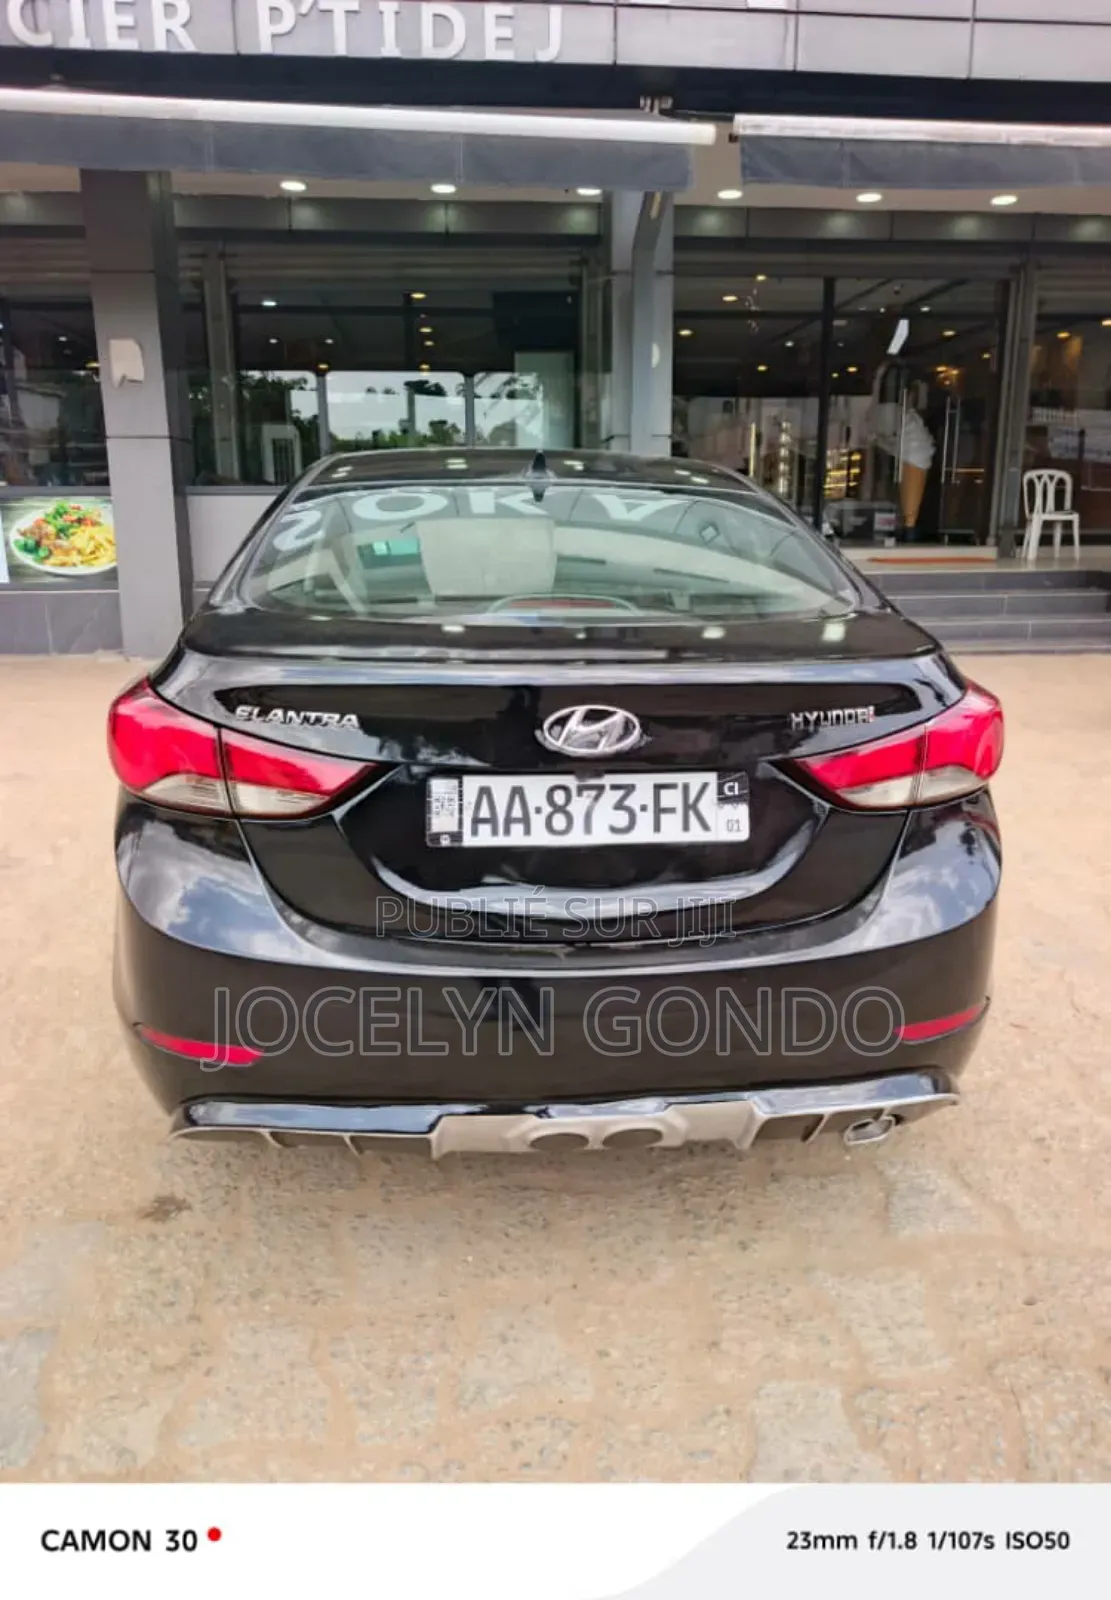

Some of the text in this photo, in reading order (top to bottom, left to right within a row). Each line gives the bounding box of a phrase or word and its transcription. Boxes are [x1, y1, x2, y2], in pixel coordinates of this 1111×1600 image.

[235, 704, 360, 729] ELANTRA
[790, 705, 876, 732] HYUNDAI
[724, 781, 739, 795] CI
